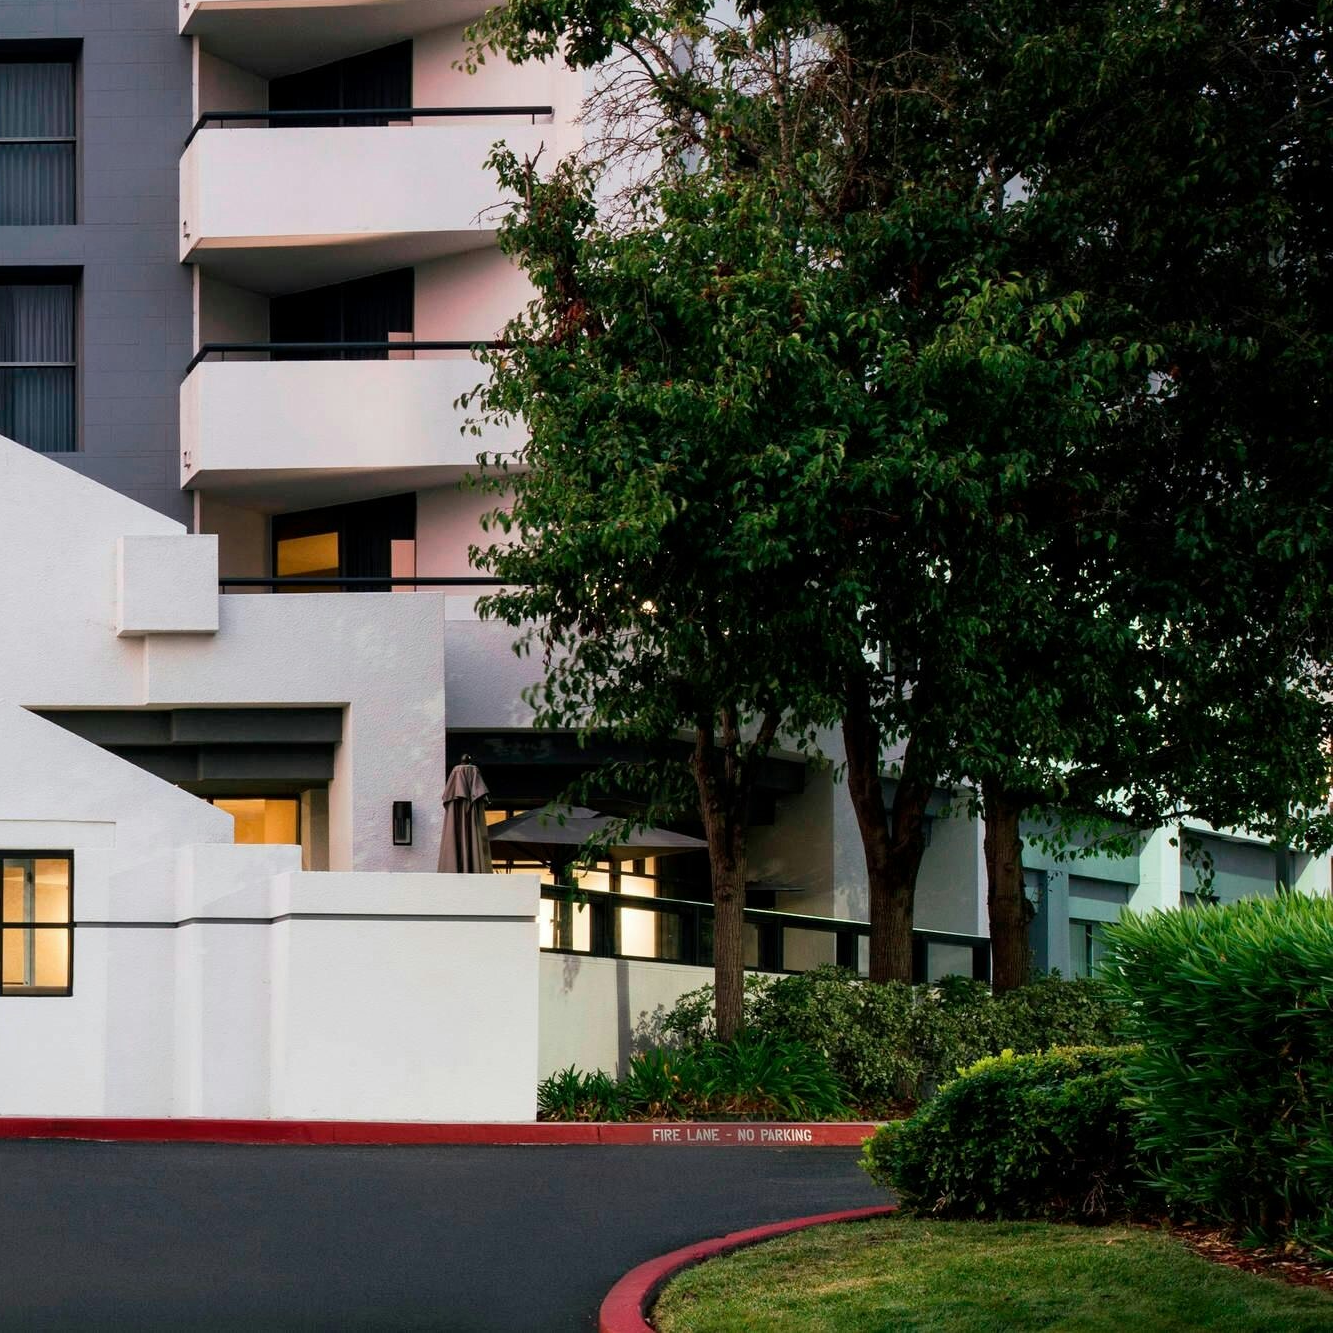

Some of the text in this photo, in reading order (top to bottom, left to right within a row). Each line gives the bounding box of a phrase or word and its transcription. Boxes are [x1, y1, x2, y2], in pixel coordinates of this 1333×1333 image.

[652, 1128, 681, 1142] FIRE
[687, 1128, 720, 1142] LANE
[737, 1128, 755, 1142] NO
[761, 1128, 812, 1142] PARKING
